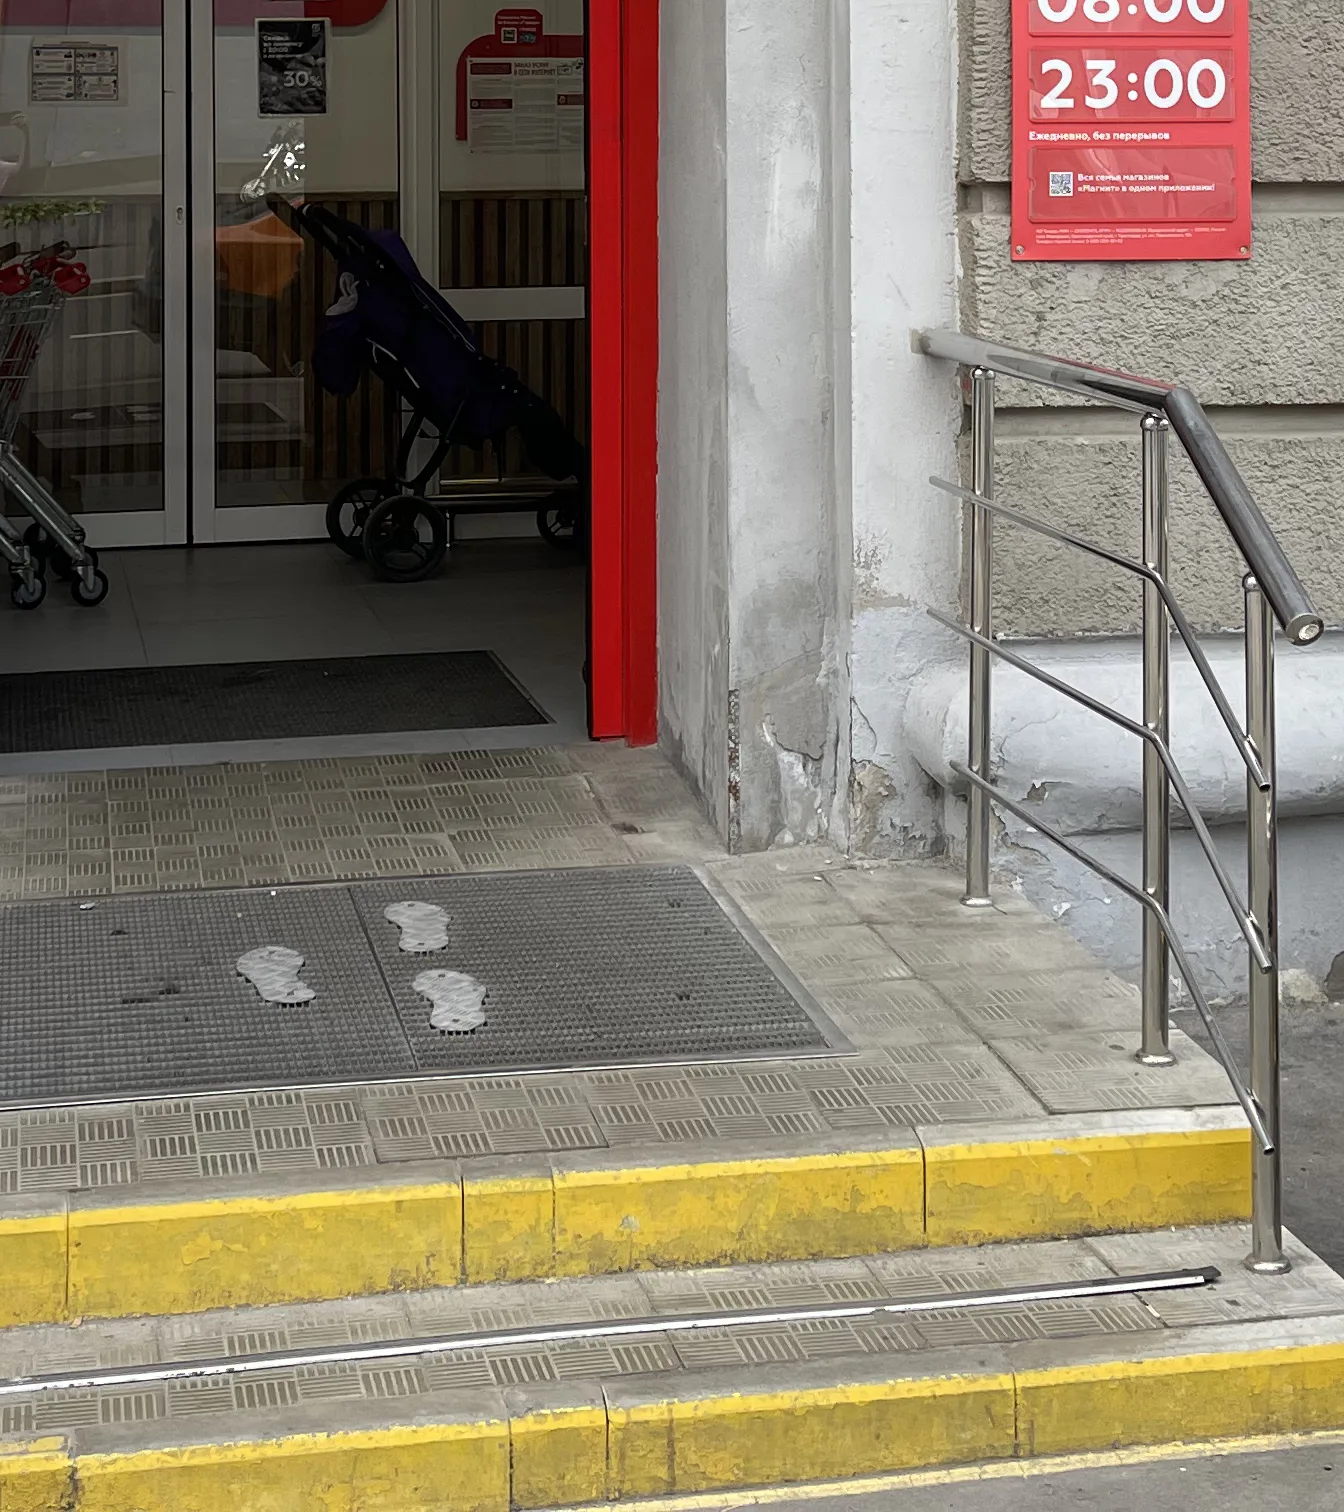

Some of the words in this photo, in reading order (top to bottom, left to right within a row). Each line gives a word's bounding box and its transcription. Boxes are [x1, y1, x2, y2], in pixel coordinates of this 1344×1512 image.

[283, 71, 323, 87] 30%
[1040, 58, 1226, 109] 23:00
[1029, 131, 1091, 141] Ежедневно,
[1093, 131, 1111, 140] без
[1112, 132, 1170, 142] перерывов
[1077, 173, 1094, 181] Вся
